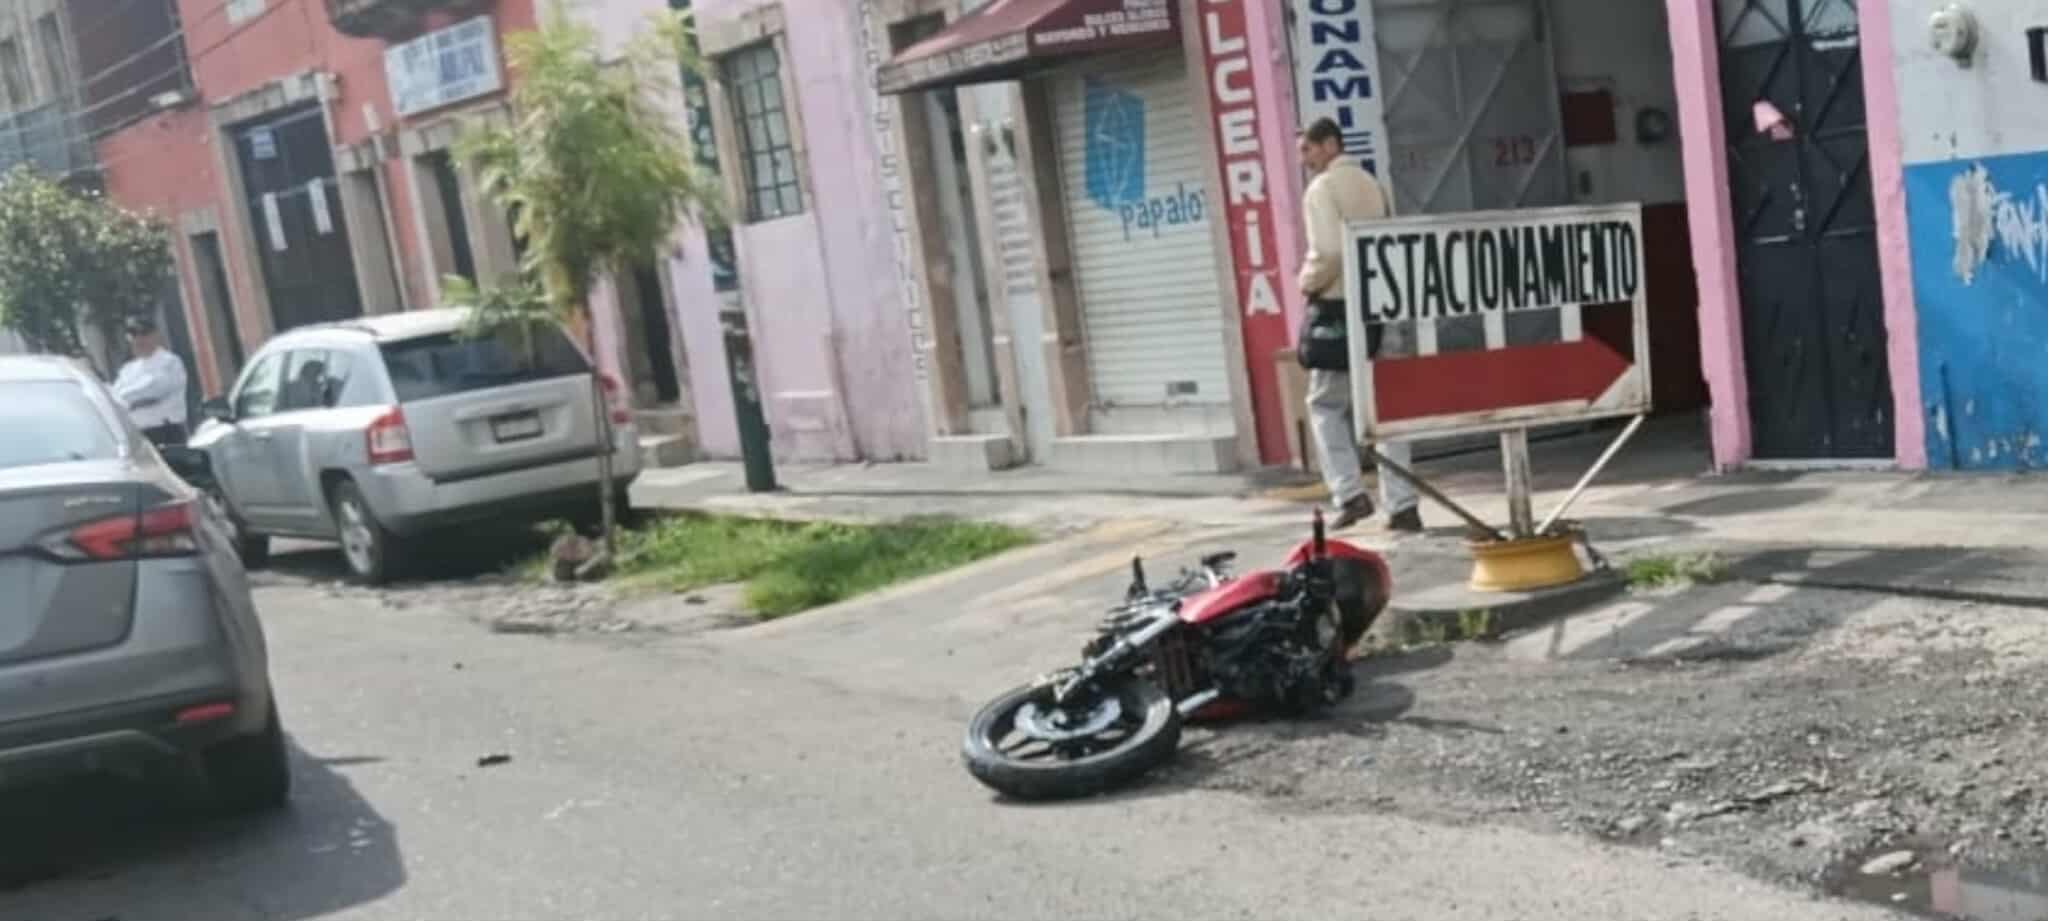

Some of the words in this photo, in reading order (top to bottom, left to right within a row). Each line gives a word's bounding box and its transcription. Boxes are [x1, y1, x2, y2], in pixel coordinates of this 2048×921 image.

[1310, 0, 1377, 174] ONAMIE
[1119, 181, 1206, 242] papalo
[1206, 0, 1281, 317] LCERiA
[1357, 221, 1638, 321] ESTACIONAMIENTO
